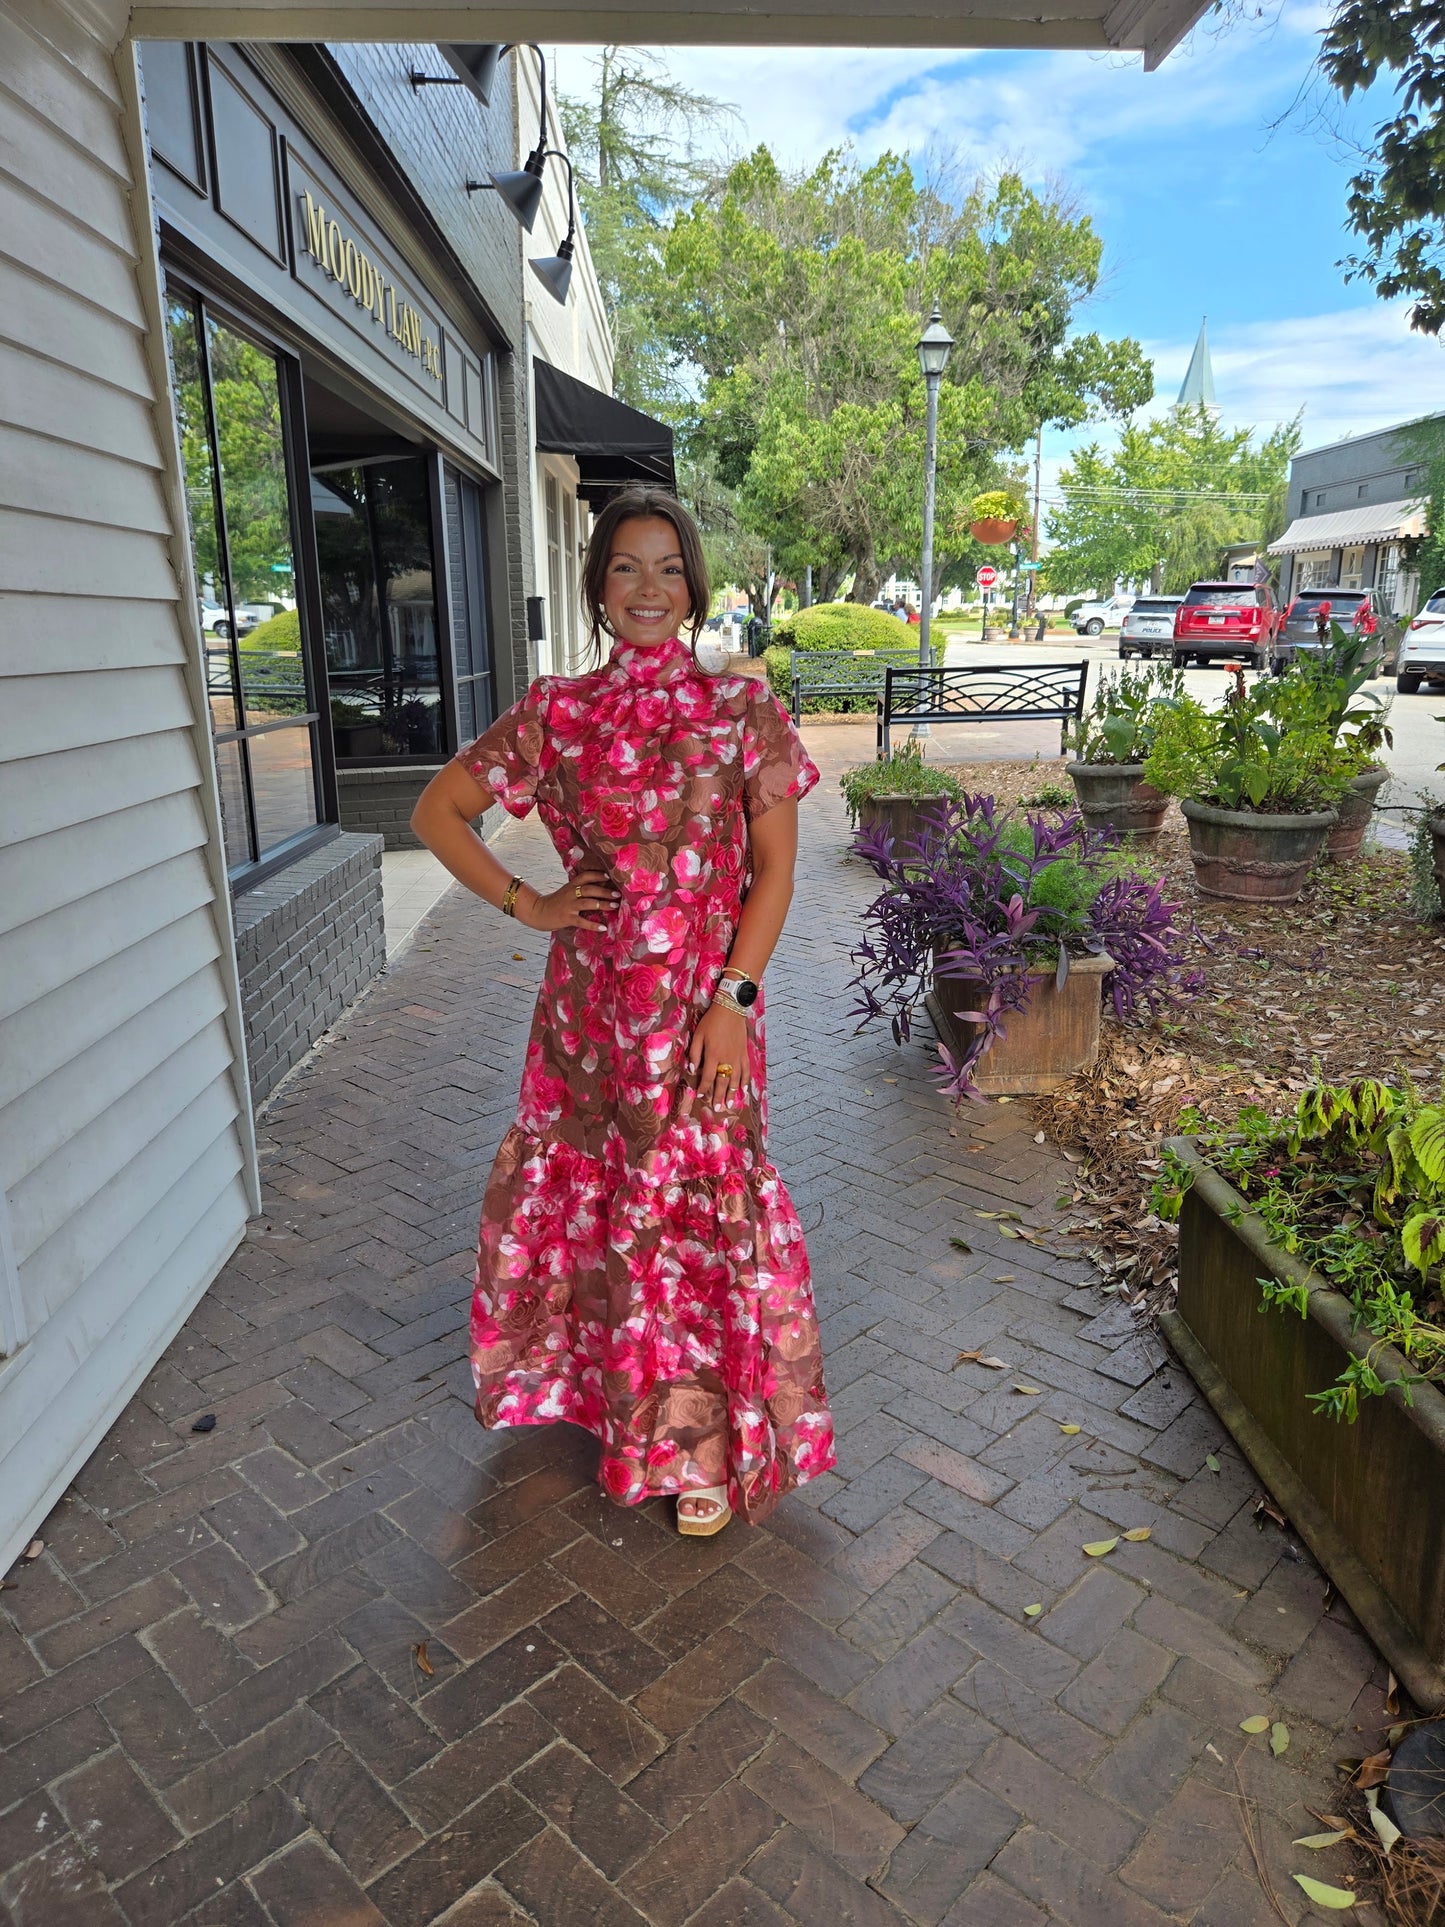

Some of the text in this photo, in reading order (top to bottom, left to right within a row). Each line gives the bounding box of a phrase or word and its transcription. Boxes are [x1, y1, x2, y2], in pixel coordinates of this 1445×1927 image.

[304, 189, 385, 326] MOODY
[390, 284, 421, 358] LAW
[979, 572, 995, 581] STOP
